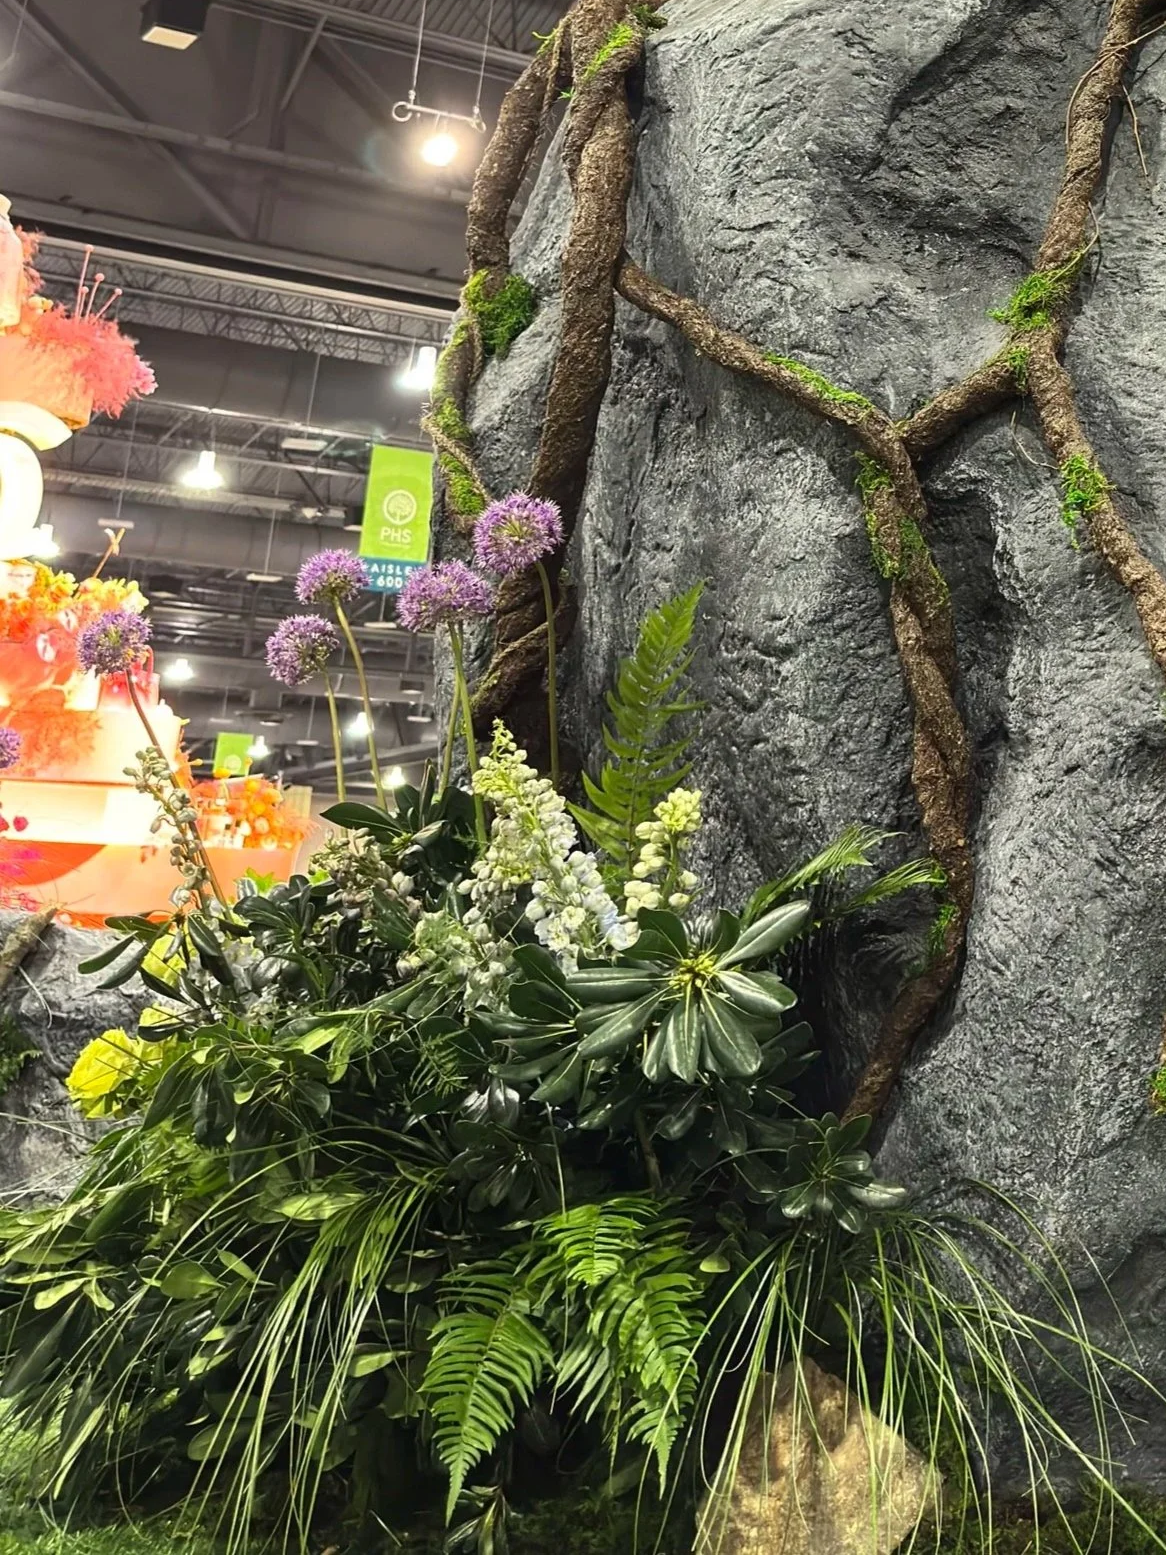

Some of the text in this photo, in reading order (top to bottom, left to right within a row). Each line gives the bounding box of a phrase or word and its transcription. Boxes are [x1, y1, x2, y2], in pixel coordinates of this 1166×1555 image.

[380, 526, 412, 543] PHS
[370, 563, 413, 576] AISLE
[377, 575, 403, 588] 600
